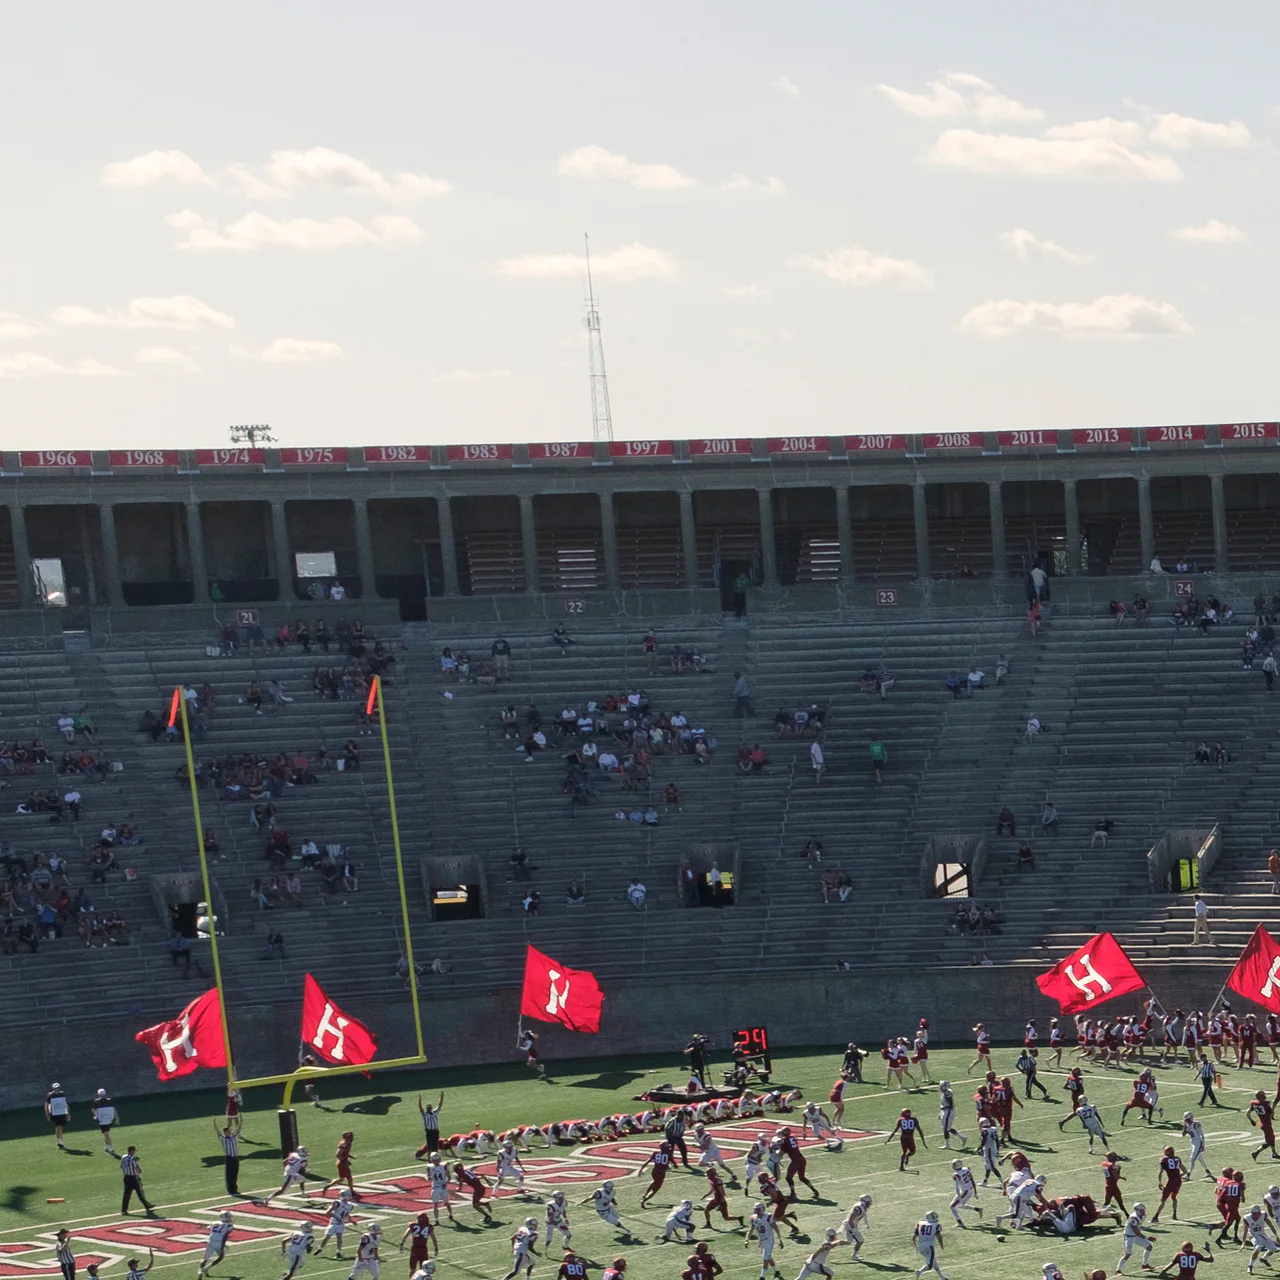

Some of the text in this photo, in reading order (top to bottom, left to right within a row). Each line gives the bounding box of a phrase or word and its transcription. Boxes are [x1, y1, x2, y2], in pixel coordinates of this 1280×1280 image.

[1011, 430, 1044, 445] 2011
[1086, 429, 1119, 443] 2013
[1160, 427, 1192, 441] 2014
[1233, 424, 1265, 438] 2015
[704, 440, 737, 453] 2001
[782, 438, 816, 450] 2004
[859, 436, 892, 450] 2007
[936, 434, 970, 447] 2008
[380, 447, 416, 460] 1982
[463, 445, 498, 458] 1983
[544, 443, 578, 457] 1987
[625, 442, 659, 455] 1997
[37, 451, 77, 466] 1966
[125, 451, 164, 465] 1968
[213, 450, 249, 464] 1974
[297, 449, 333, 462] 1975
[1177, 582, 1192, 594] 24
[881, 591, 894, 603] 23
[568, 601, 582, 612] 22
[241, 612, 253, 623] 21
[1064, 954, 1113, 1001] H
[313, 1005, 348, 1060] H
[901, 1119, 914, 1130] 80
[654, 1154, 668, 1165] 80
[412, 1225, 428, 1238] 24
[1180, 1256, 1196, 1268] 80
[567, 1264, 583, 1276] 80
